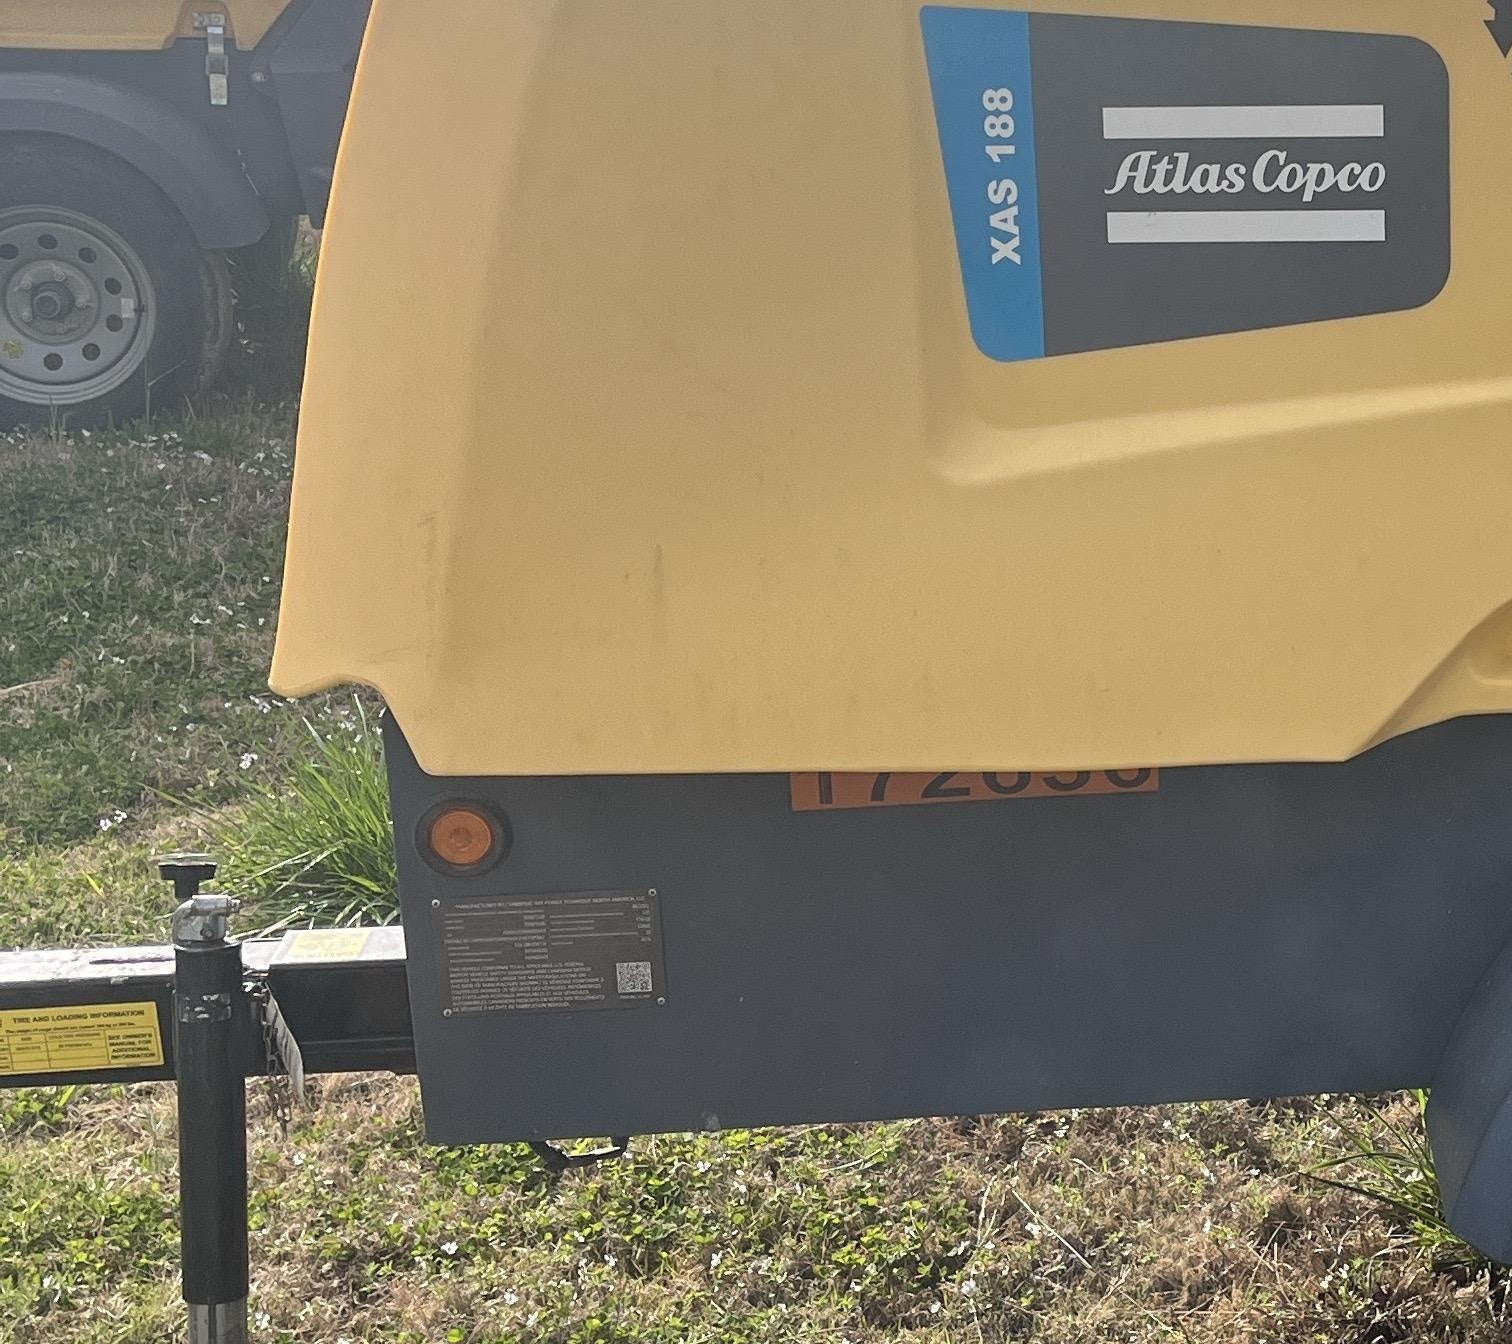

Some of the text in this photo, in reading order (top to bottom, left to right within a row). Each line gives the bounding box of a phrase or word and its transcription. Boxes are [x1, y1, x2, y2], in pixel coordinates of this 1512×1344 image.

[982, 87, 1022, 266] XAS 188
[1104, 149, 1386, 203] Atlas Copco
